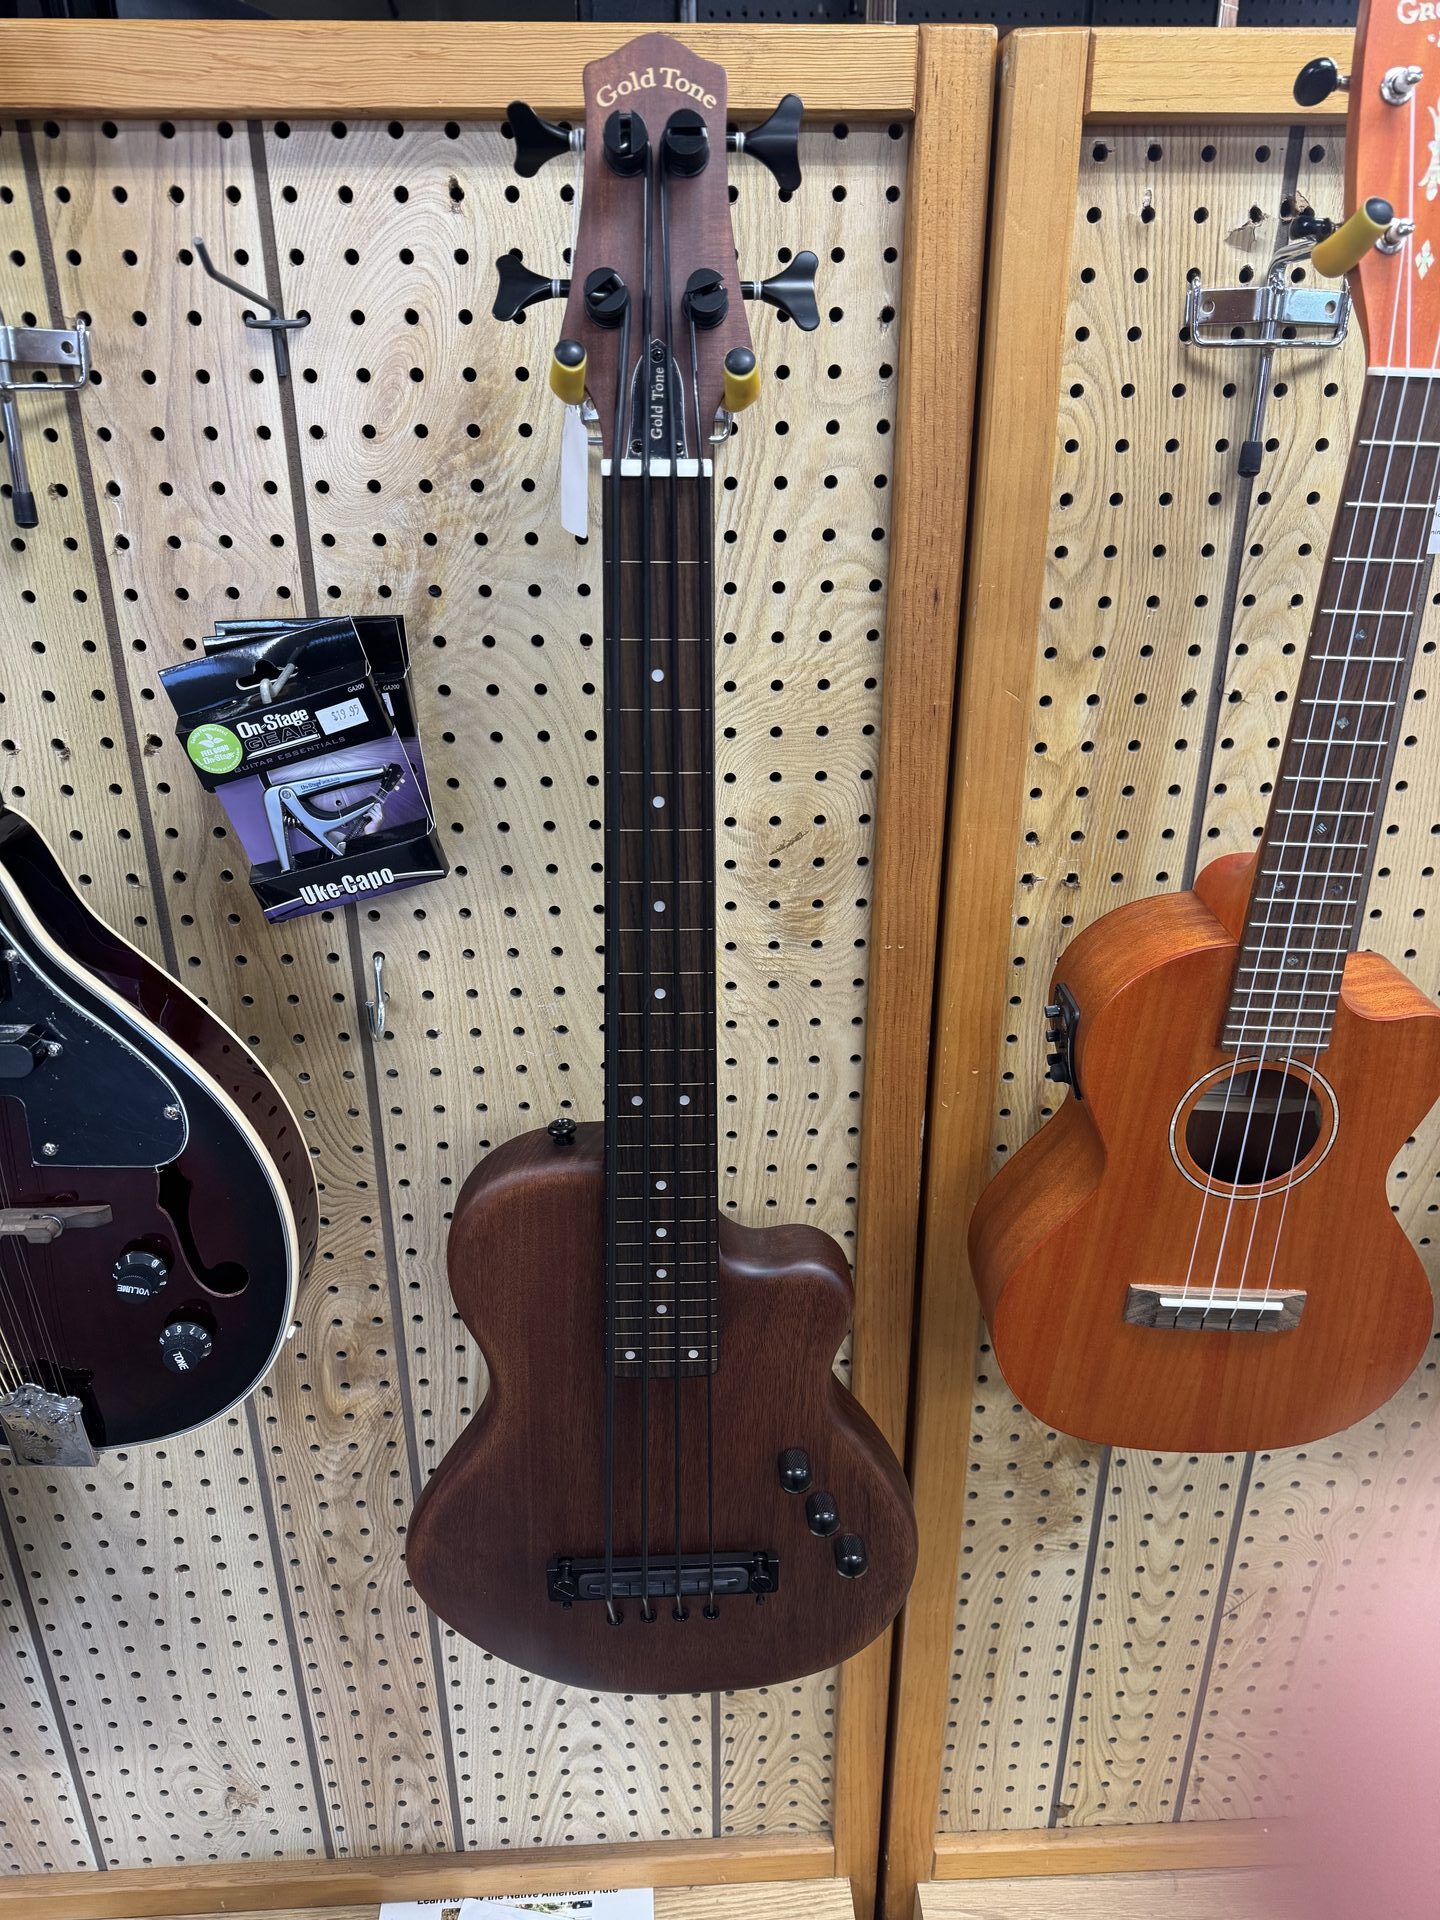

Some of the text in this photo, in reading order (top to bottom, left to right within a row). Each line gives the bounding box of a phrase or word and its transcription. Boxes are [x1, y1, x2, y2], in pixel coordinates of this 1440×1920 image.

[596, 67, 717, 109] Gold Tone
[650, 367, 665, 439] Gold Tone
[347, 683, 365, 693] GA200
[236, 709, 309, 739] On-Stage
[244, 721, 319, 752] GEAR
[234, 736, 346, 774] GUITAR ESSENTIALS
[299, 867, 395, 905] Uke-Capo
[116, 1284, 150, 1297] VOLUME
[172, 1350, 190, 1371] TONE
